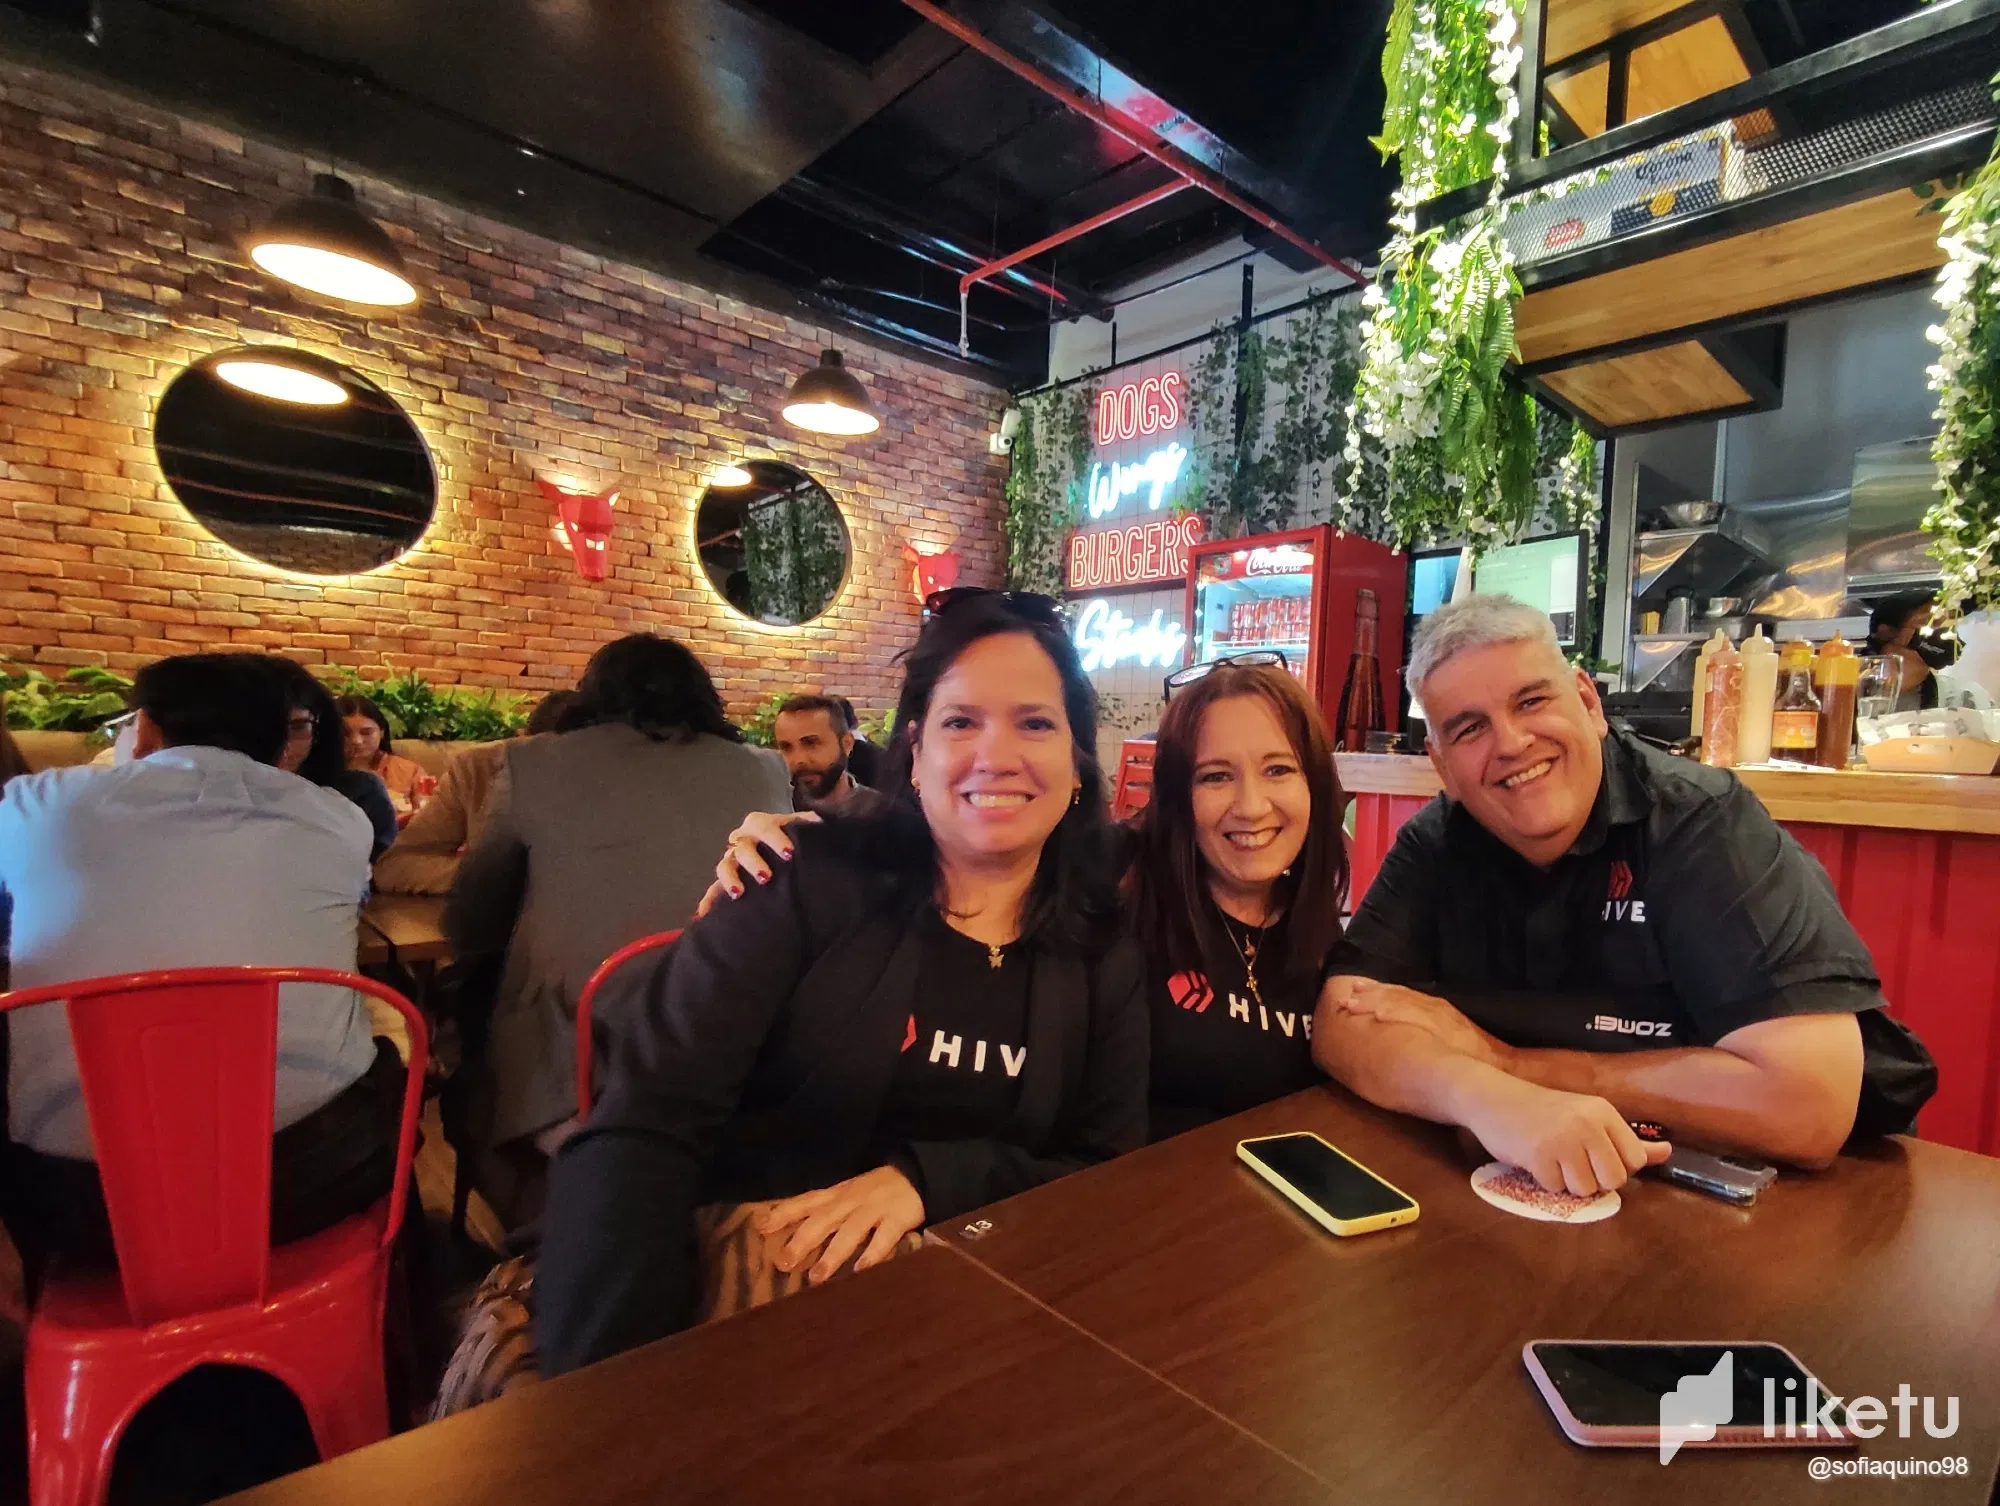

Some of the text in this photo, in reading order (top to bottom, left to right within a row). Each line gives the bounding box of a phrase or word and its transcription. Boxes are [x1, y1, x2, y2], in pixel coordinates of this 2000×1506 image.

[1099, 372, 1180, 445] DOGS
[1070, 515, 1201, 588] BURGERS
[1601, 900, 1646, 922] IVE
